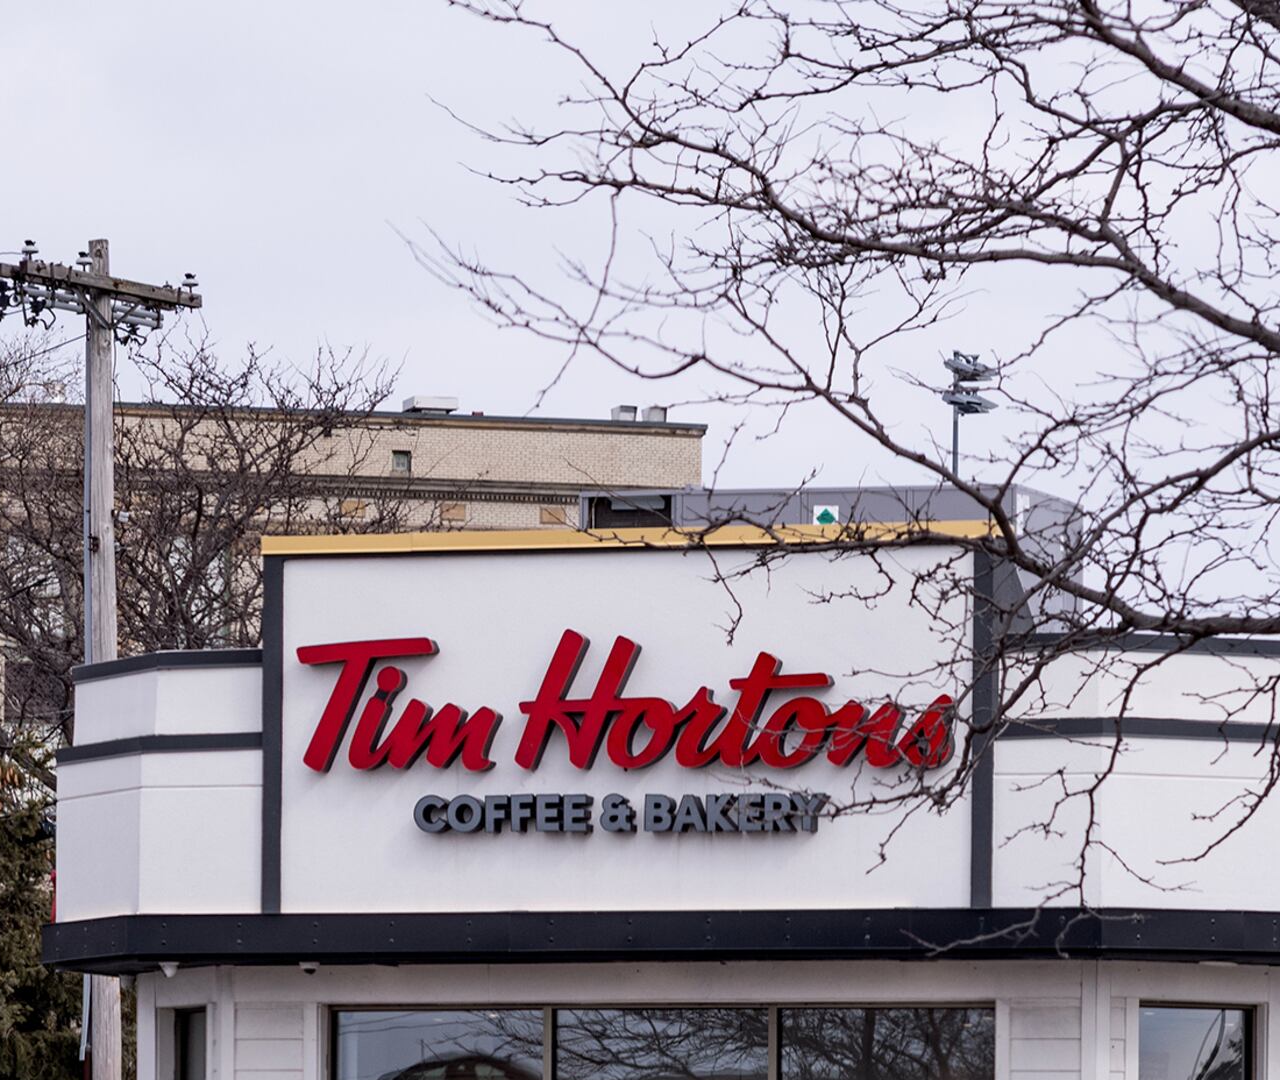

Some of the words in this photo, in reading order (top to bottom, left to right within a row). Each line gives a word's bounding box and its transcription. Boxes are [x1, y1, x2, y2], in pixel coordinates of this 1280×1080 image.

[296, 636, 497, 775] Tim
[514, 628, 956, 773] Hortons
[413, 793, 594, 834] COFFEE
[599, 794, 638, 833] &
[643, 793, 830, 834] BAKERY
